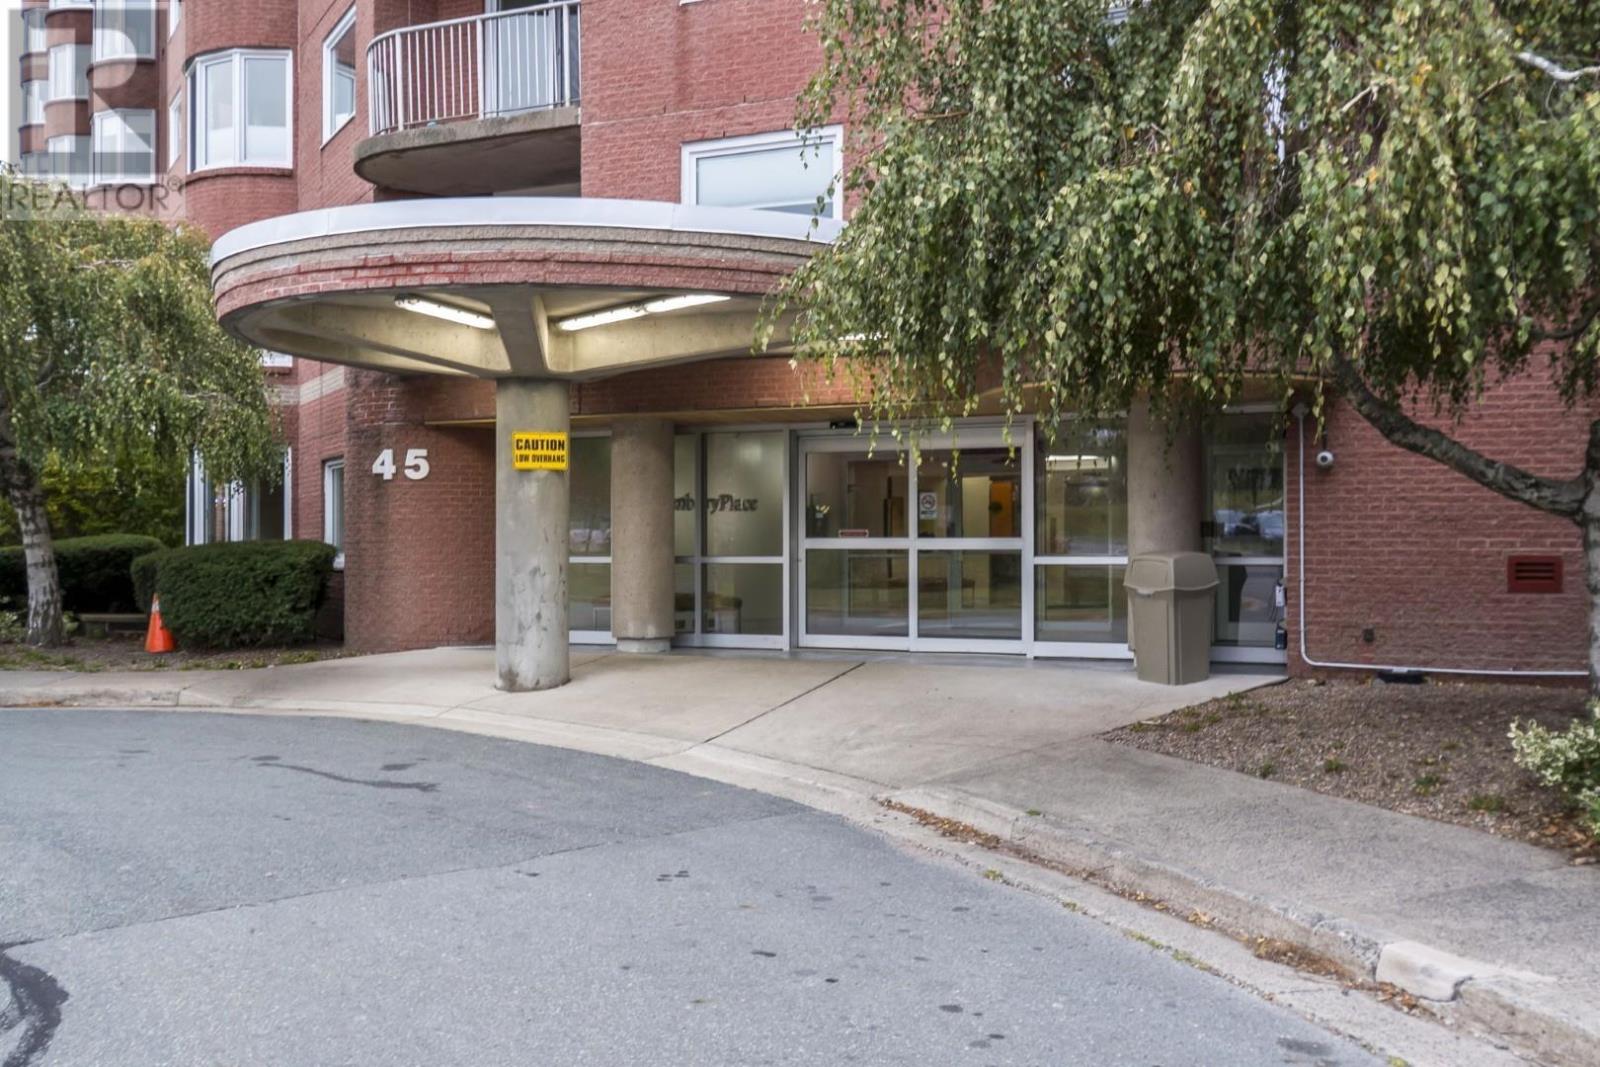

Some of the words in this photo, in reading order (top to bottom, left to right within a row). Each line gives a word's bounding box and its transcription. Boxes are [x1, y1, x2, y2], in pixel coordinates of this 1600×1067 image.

[515, 438, 565, 451] CAUTION
[515, 453, 529, 463] LOW
[531, 453, 565, 463] OVERHANG
